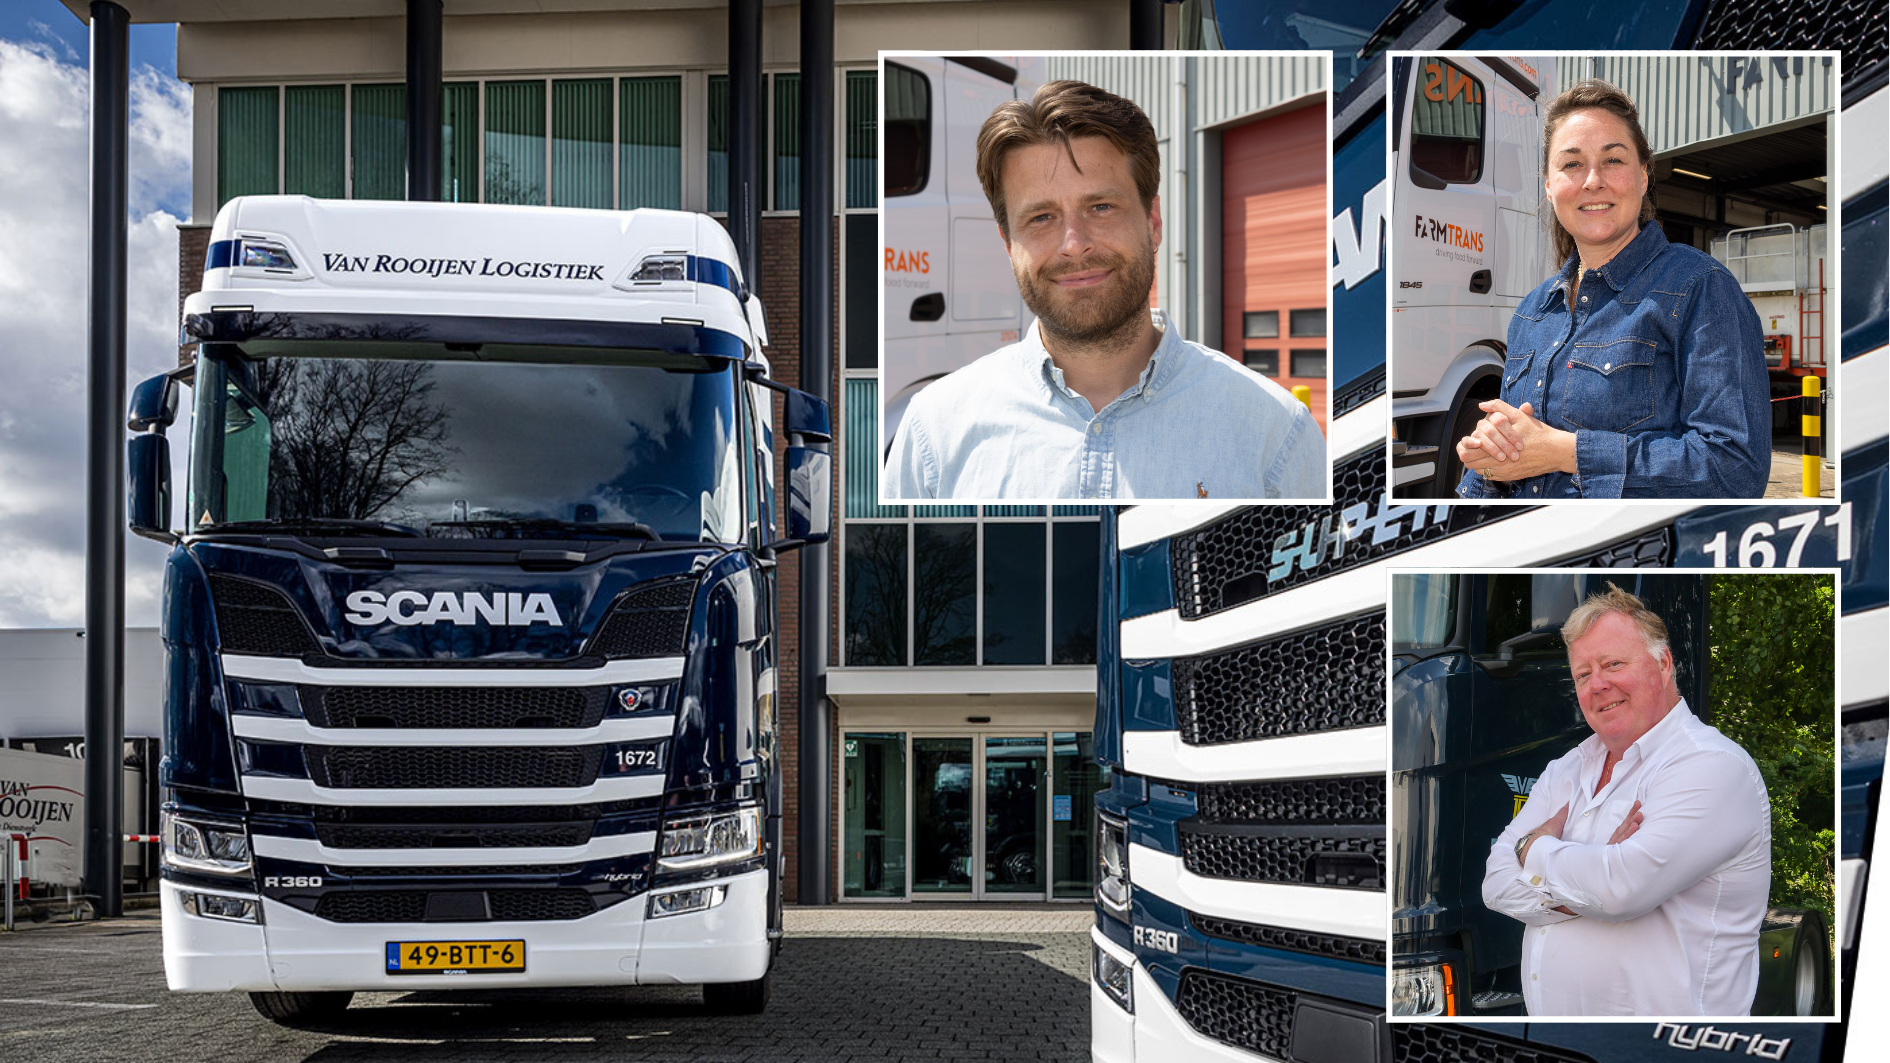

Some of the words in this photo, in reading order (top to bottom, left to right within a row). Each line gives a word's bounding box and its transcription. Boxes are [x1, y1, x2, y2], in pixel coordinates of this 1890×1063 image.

[1415, 215, 1484, 252] FARMTRANS
[322, 253, 370, 272] VAN
[372, 254, 477, 278] ROOIJEN
[479, 258, 605, 281] LOGISTIEK
[1435, 247, 1454, 261] driving
[1454, 250, 1466, 262] food
[1703, 501, 1852, 567] 1671
[344, 590, 563, 626] SCANIA
[615, 751, 656, 765] 1672
[1, 781, 30, 796] VAN
[265, 876, 279, 887] R
[281, 876, 322, 887] 360
[1134, 925, 1145, 946] R
[1145, 928, 1178, 954] 360
[408, 944, 515, 965] 49-BTT-6
[1653, 1022, 1791, 1061] hybrid
